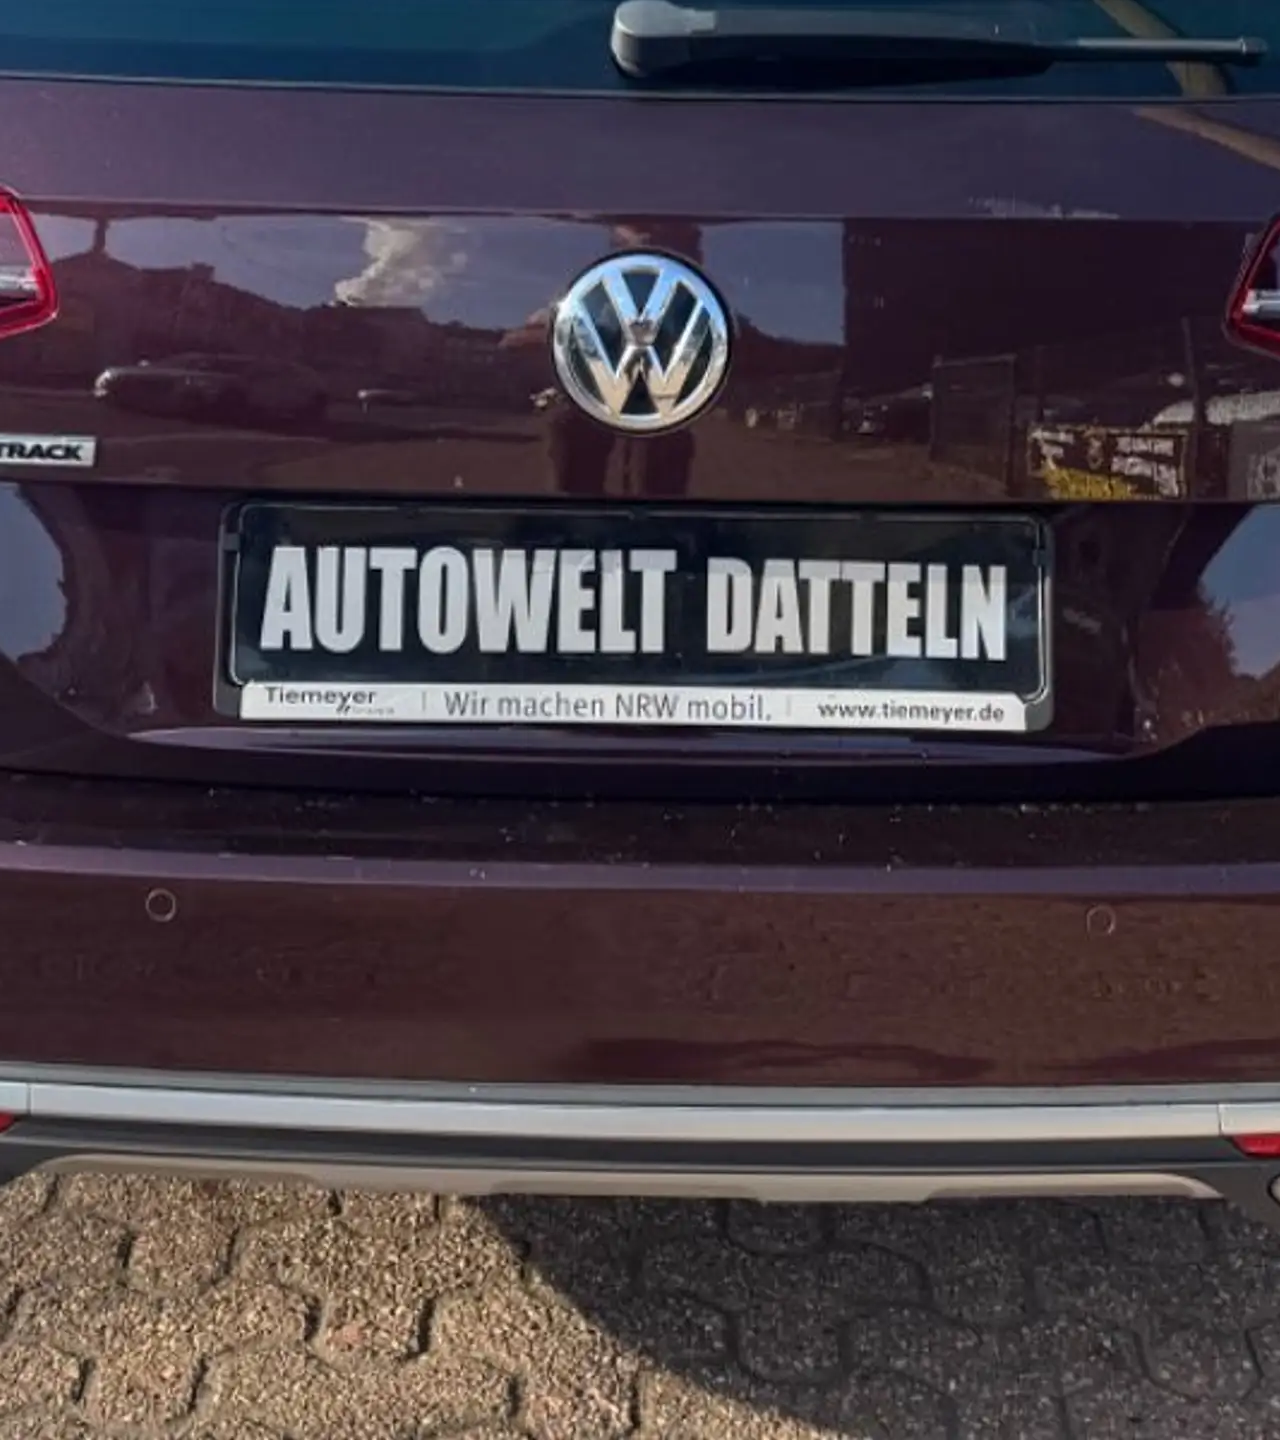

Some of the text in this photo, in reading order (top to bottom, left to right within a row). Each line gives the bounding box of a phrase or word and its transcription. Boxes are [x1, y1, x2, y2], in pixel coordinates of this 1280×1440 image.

[260, 545, 1008, 661] AUTOWELT DATTELN
[265, 686, 378, 715] Tiemeyer
[444, 692, 773, 722] Wir machen NRW mobil.
[816, 701, 1005, 724] www.tiemeyer.de
